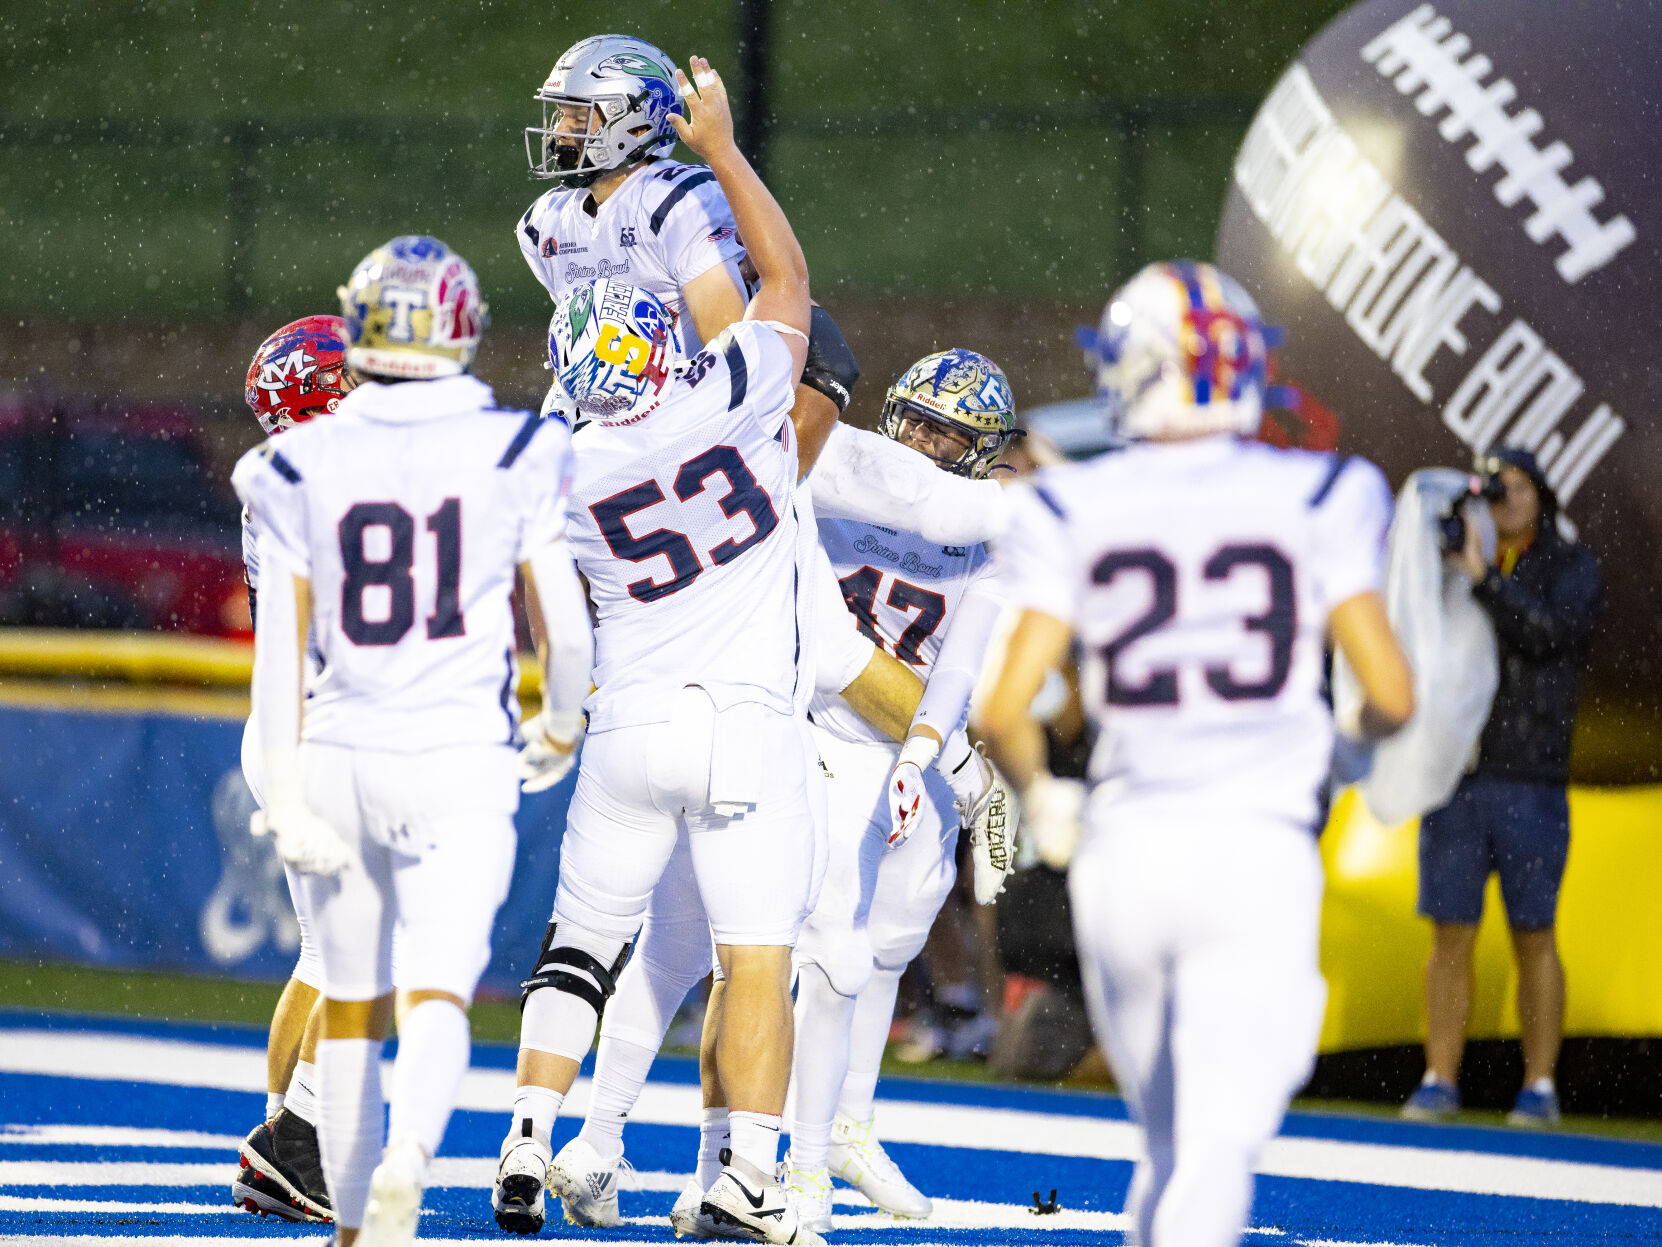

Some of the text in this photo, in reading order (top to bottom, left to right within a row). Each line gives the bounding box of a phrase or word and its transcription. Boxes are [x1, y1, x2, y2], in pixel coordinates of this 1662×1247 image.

[565, 258, 631, 285] Shrine Bowl
[917, 393, 947, 411] Riddell
[338, 496, 466, 646] 81
[588, 444, 780, 604] 53
[853, 534, 900, 563] Shrine
[899, 551, 944, 578] Bowl
[1089, 542, 1298, 707] 23
